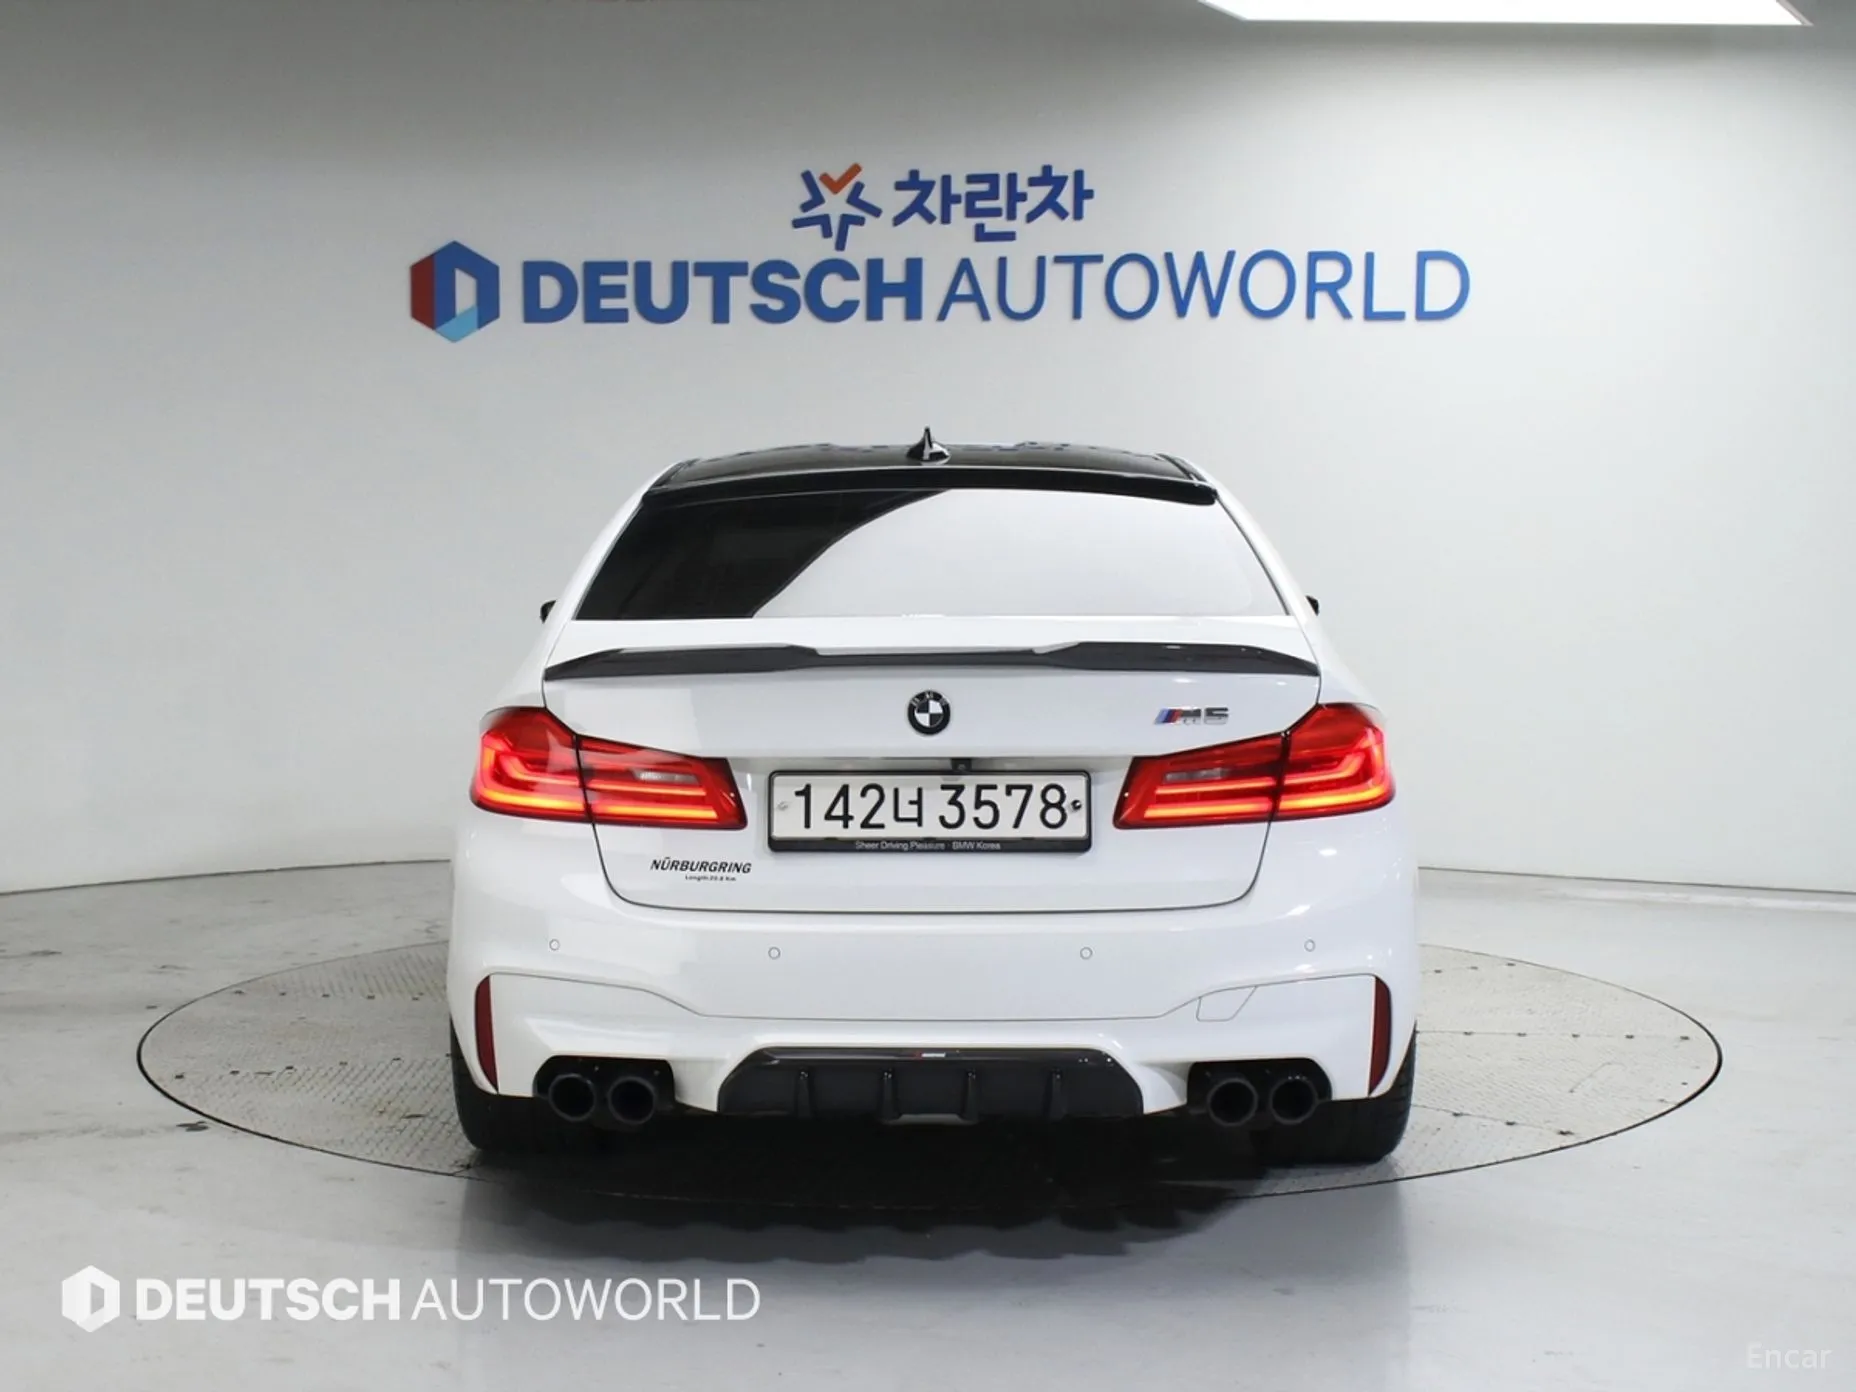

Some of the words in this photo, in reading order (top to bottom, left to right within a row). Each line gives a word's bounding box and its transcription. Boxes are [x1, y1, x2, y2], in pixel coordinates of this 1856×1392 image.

[892, 163, 1095, 242] 차란차
[522, 257, 924, 325] DEUTSCH
[937, 249, 1471, 322] AUTOWORLD
[793, 783, 923, 830] 142너
[938, 783, 1069, 830] 3578
[855, 840, 879, 850] Sheer
[880, 840, 908, 851] Driving
[910, 840, 945, 850] Pleasure
[952, 840, 975, 850] BMW
[976, 840, 1000, 850] Korea
